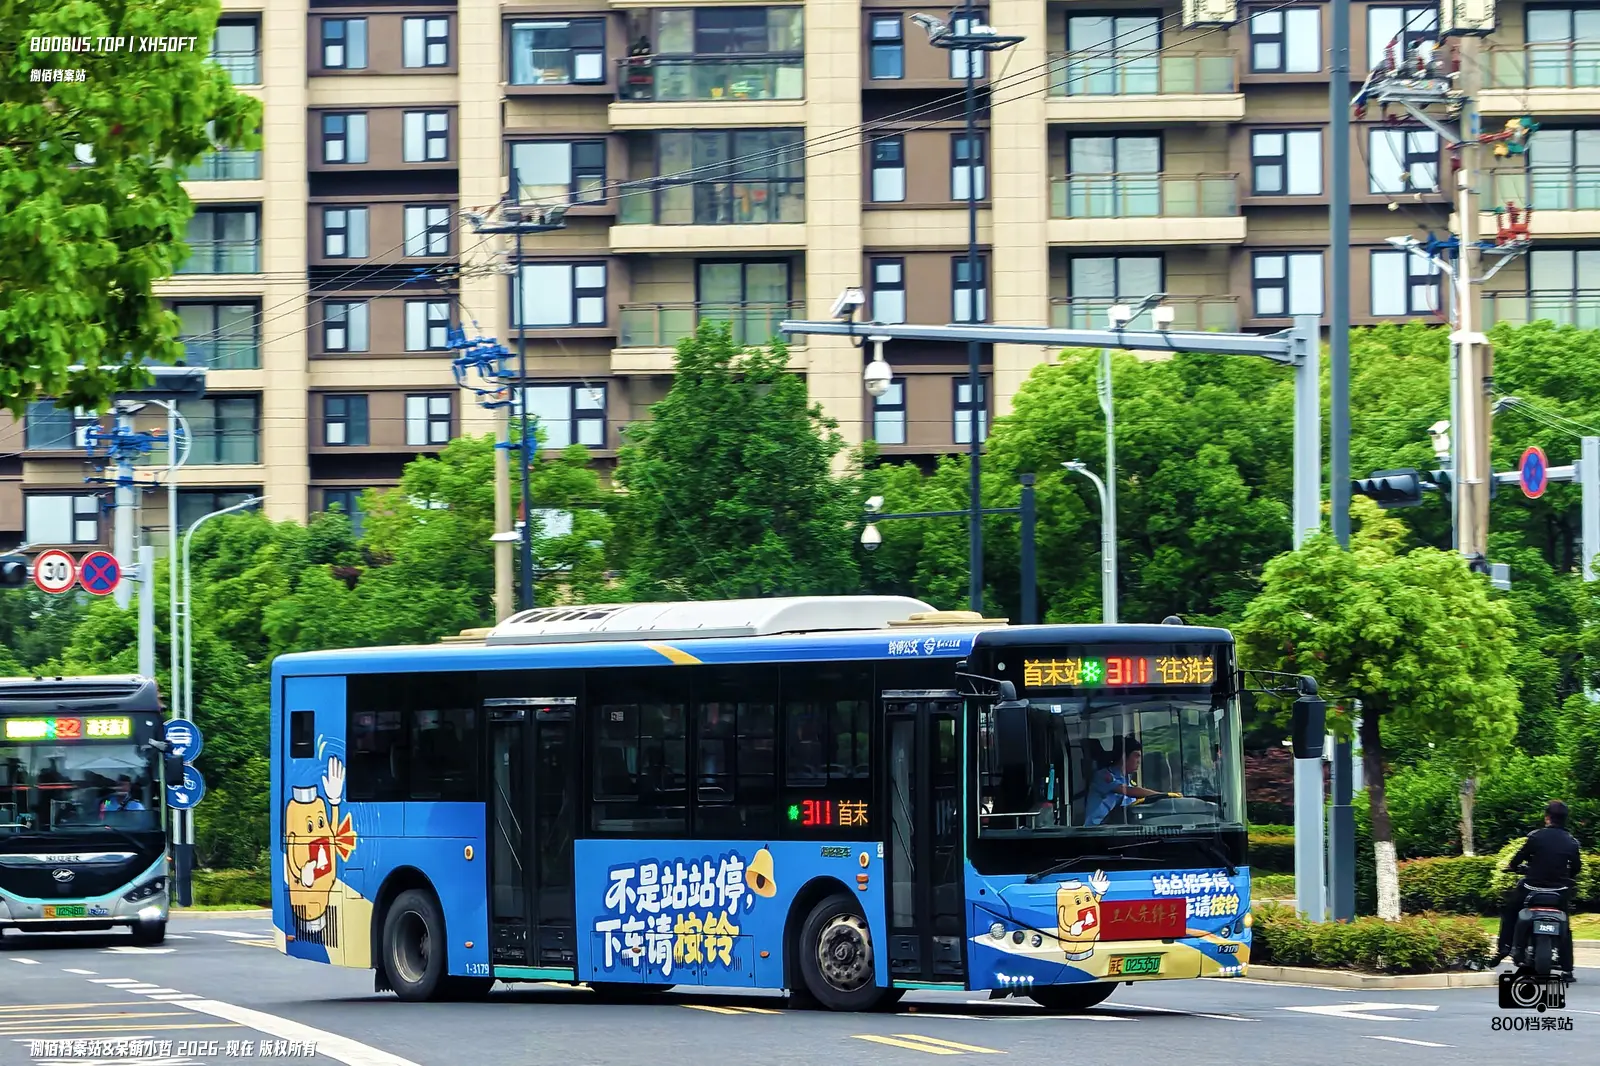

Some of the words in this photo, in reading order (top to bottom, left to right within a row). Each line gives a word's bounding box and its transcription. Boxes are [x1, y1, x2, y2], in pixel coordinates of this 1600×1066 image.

[43, 562, 68, 581] 30
[1024, 658, 1083, 687] 首末站
[1106, 657, 1148, 685] 311
[802, 799, 832, 825] 311
[838, 799, 869, 826] 首末
[595, 910, 739, 976] 下车请按铃
[465, 963, 489, 975] 1-3179
